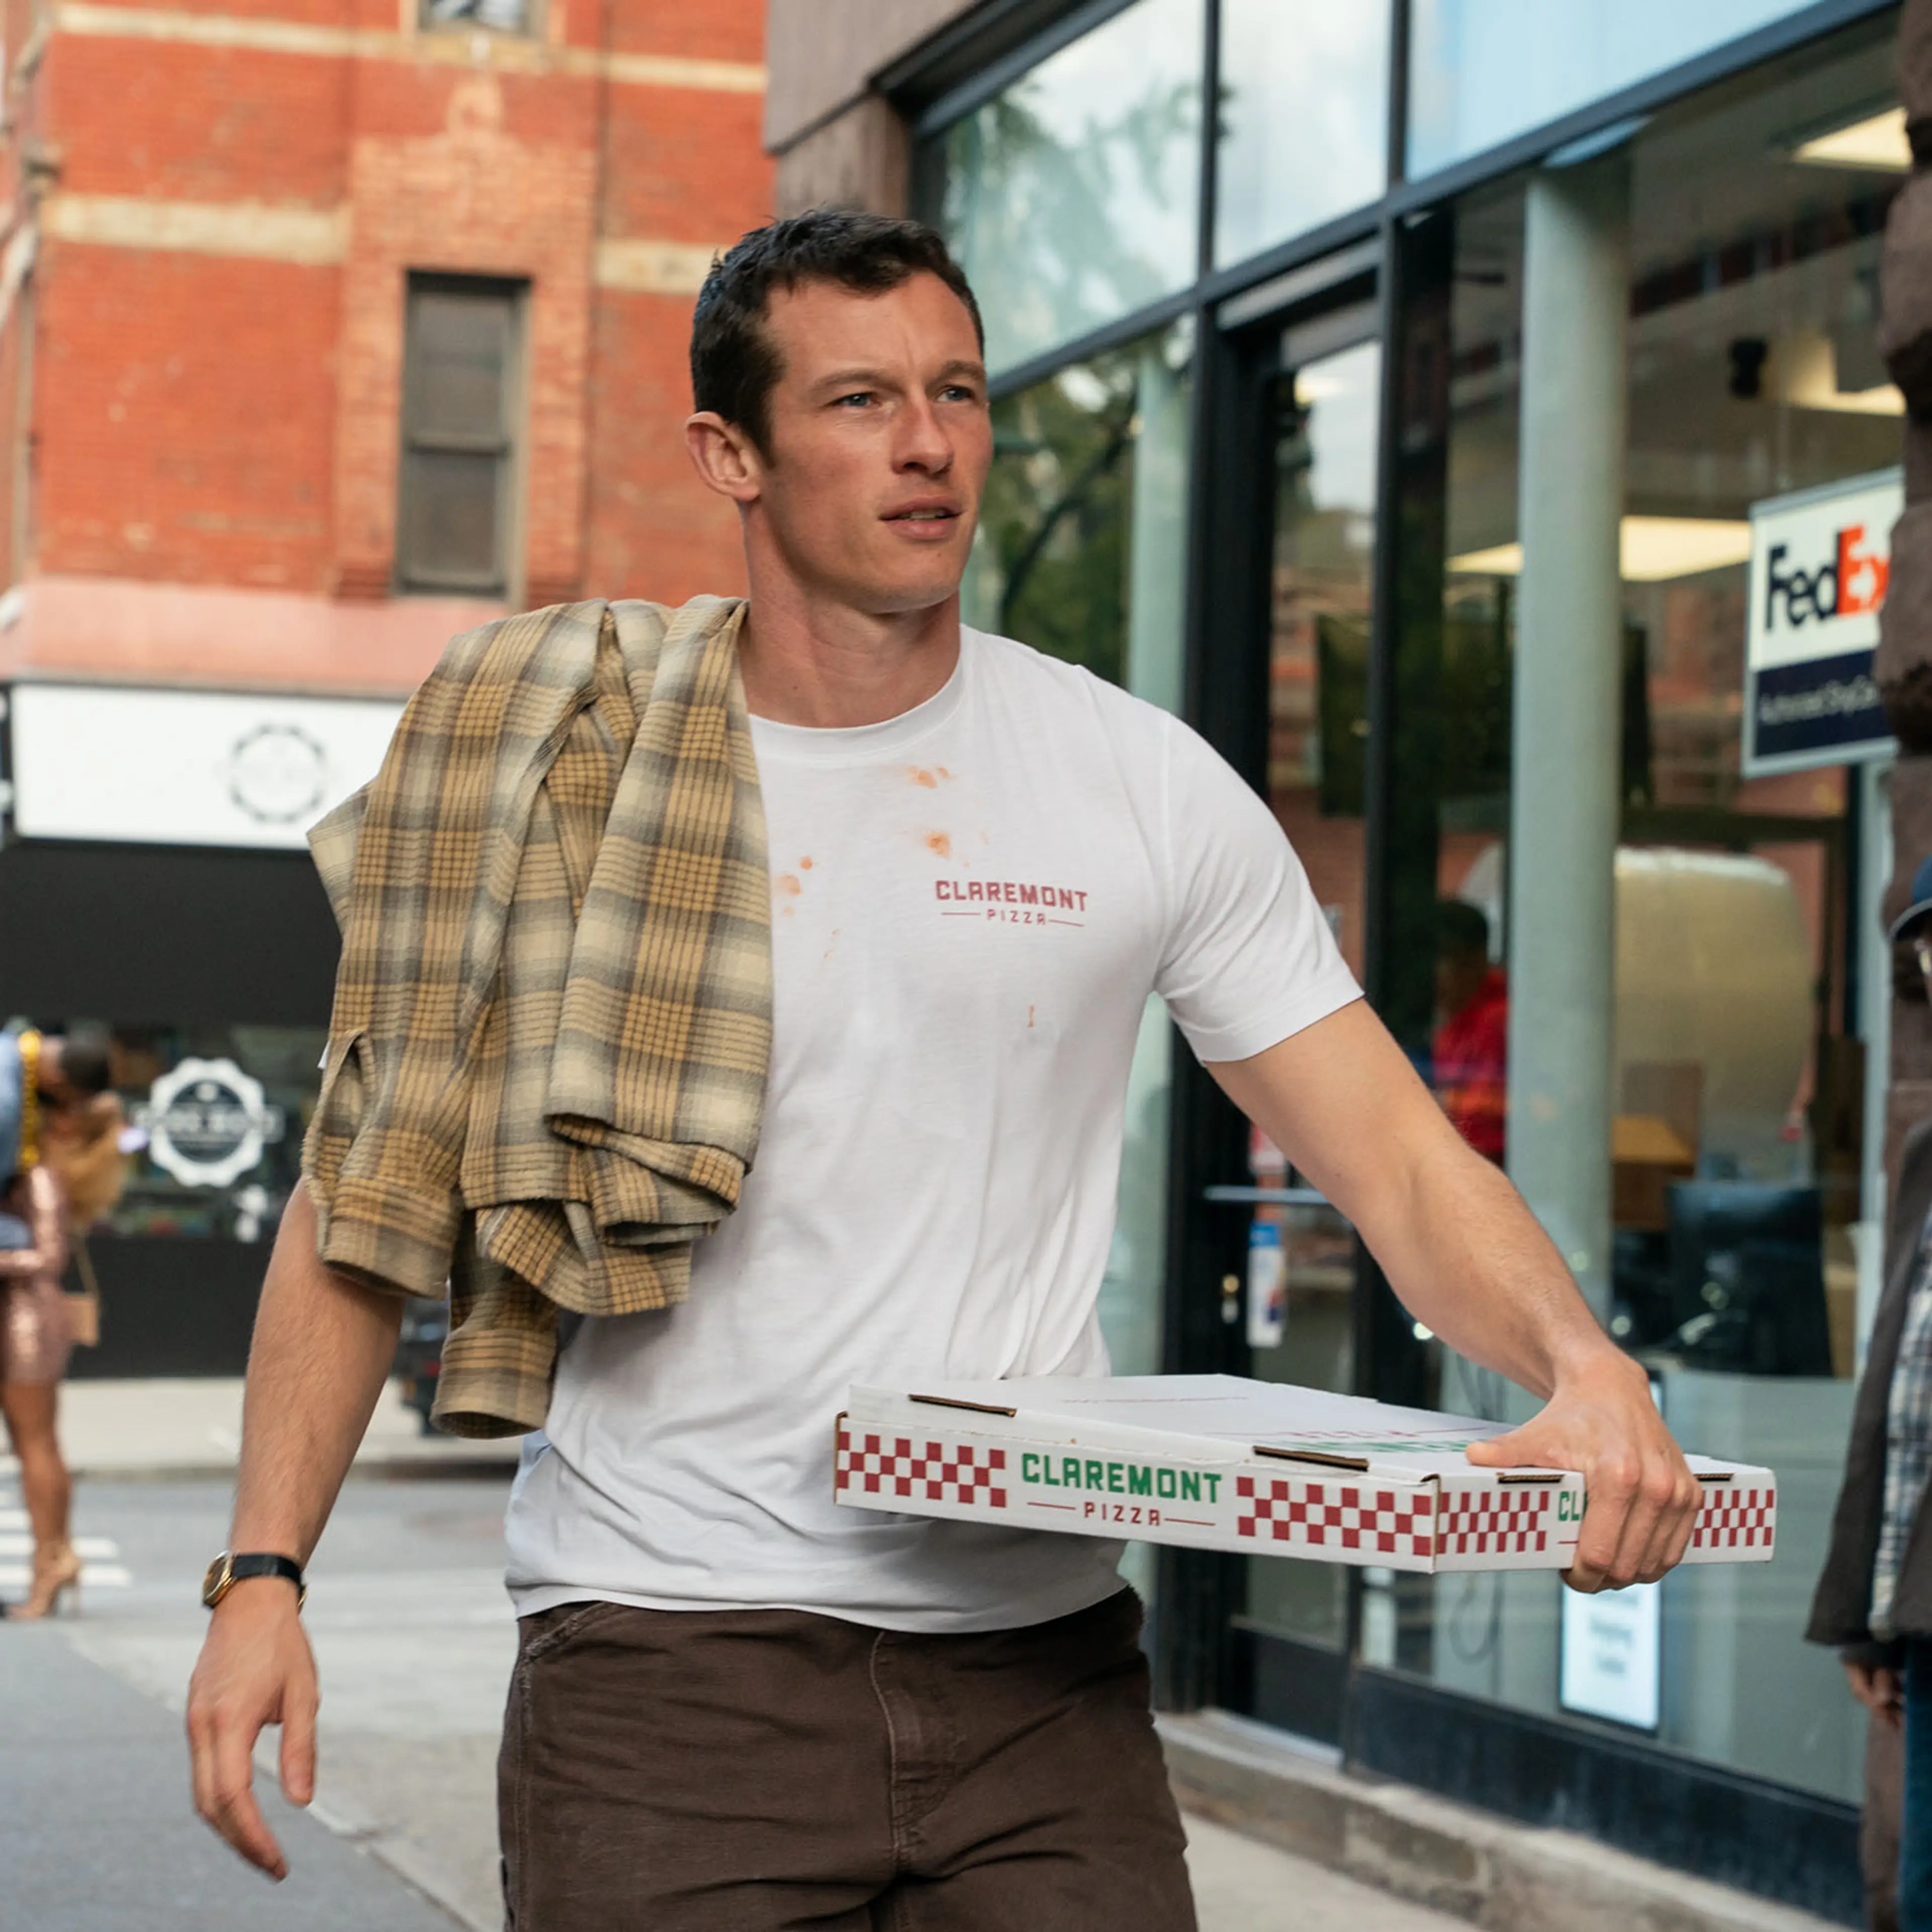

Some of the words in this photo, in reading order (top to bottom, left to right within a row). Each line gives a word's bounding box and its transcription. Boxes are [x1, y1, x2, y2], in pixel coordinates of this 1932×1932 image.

[935, 880, 1088, 912] CLAREMONT
[987, 909, 1046, 925] PIZZA
[1022, 1453, 1223, 1503] CLAREMONT
[1084, 1501, 1161, 1527] PIZZA
